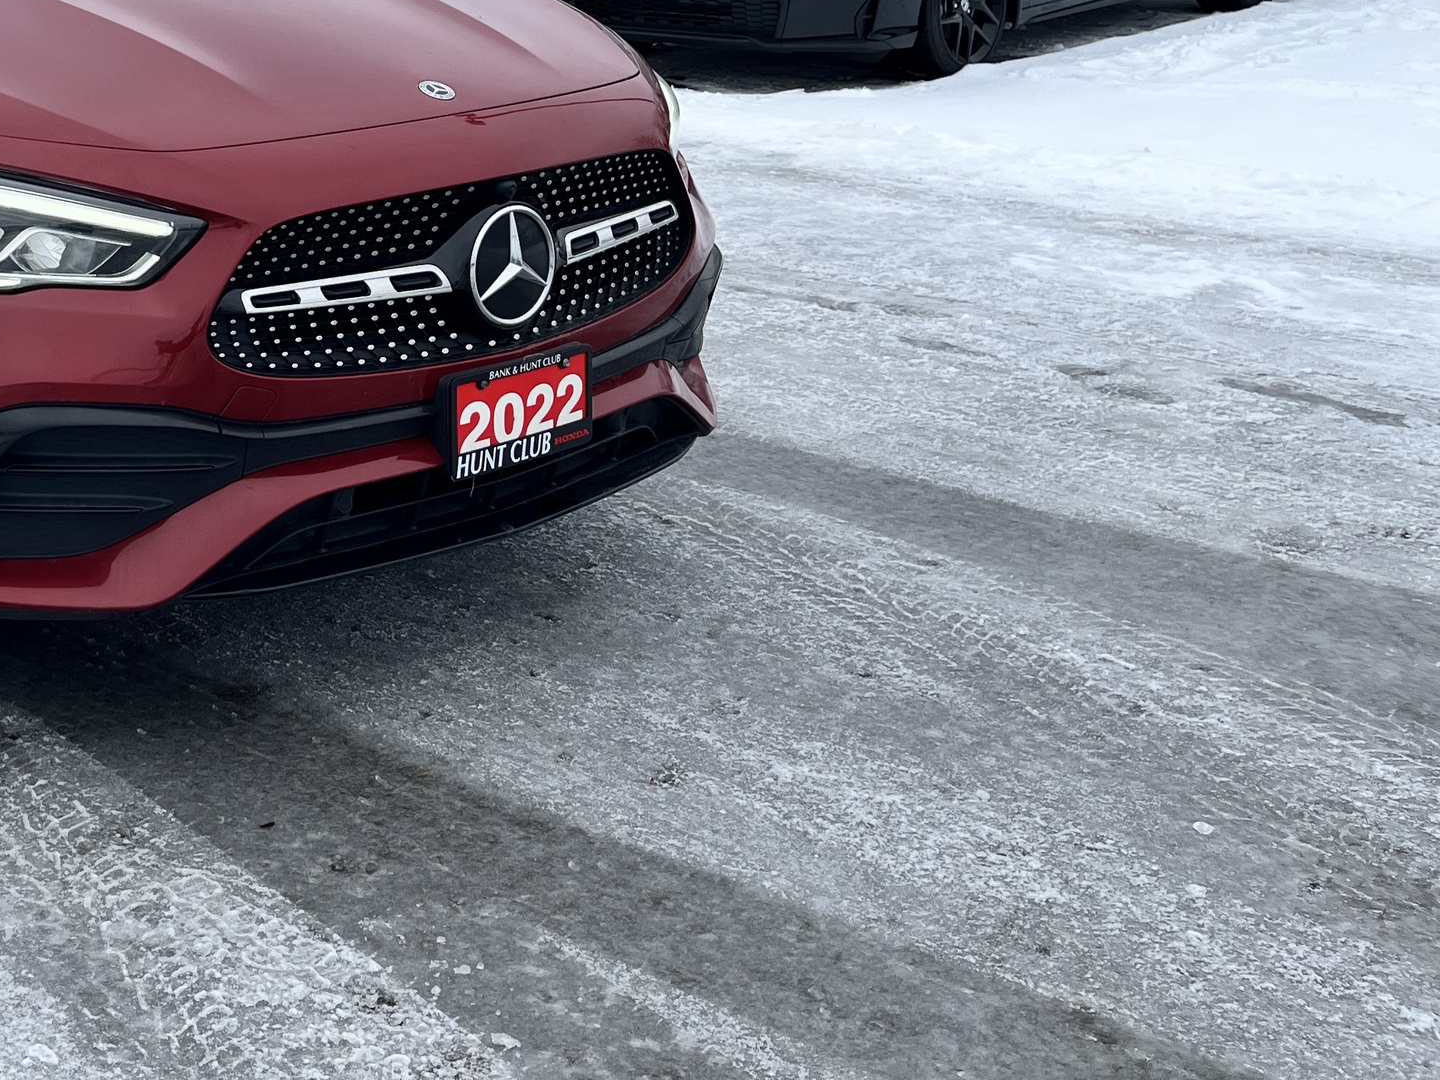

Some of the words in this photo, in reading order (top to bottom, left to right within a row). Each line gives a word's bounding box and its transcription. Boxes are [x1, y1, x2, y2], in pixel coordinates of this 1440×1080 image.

[489, 367, 511, 380] BANK
[512, 365, 518, 375] &
[520, 359, 542, 373] HUNT
[542, 353, 562, 367] CLUB
[459, 373, 583, 454] 2022
[456, 444, 507, 479] HUNT
[510, 431, 552, 463] CLUB
[554, 428, 590, 445] HONDA
